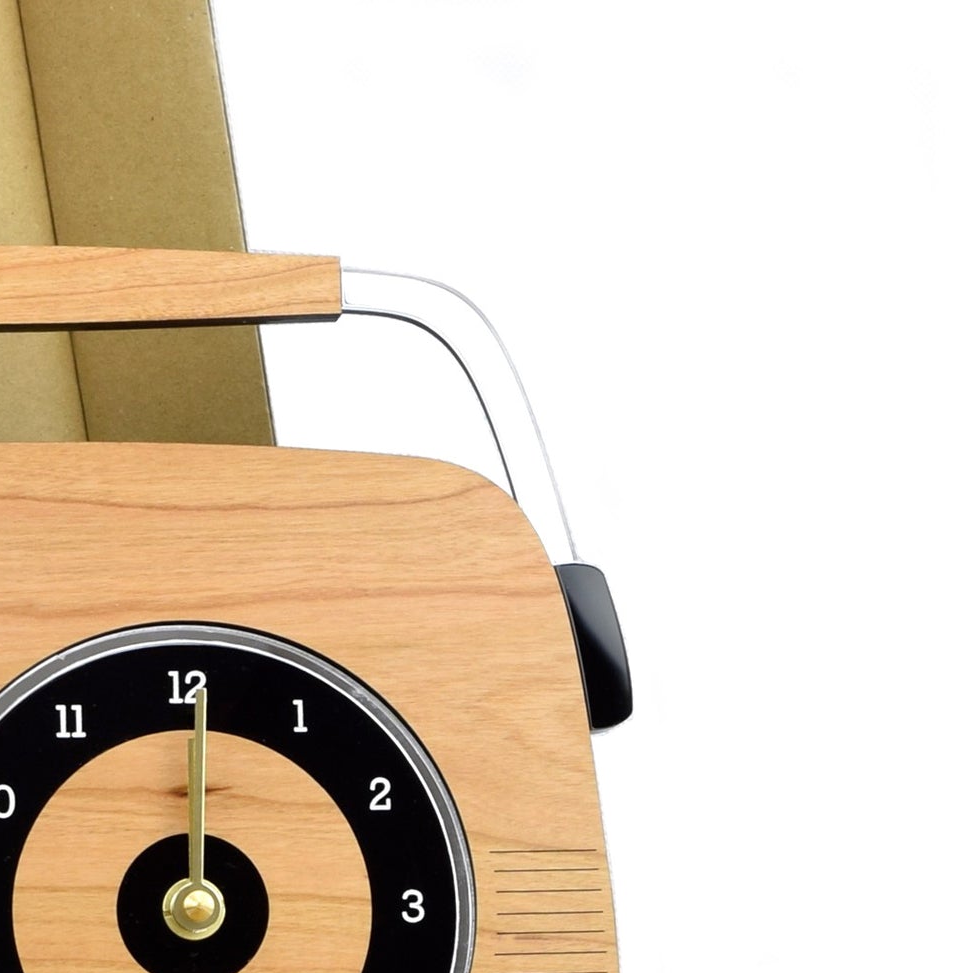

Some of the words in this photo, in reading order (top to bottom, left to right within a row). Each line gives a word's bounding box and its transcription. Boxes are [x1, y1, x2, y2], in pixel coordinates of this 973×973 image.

[168, 670, 207, 704] 12
[55, 705, 87, 738] 11
[293, 700, 309, 732] 1
[369, 777, 392, 810] 2
[401, 889, 425, 923] 3
